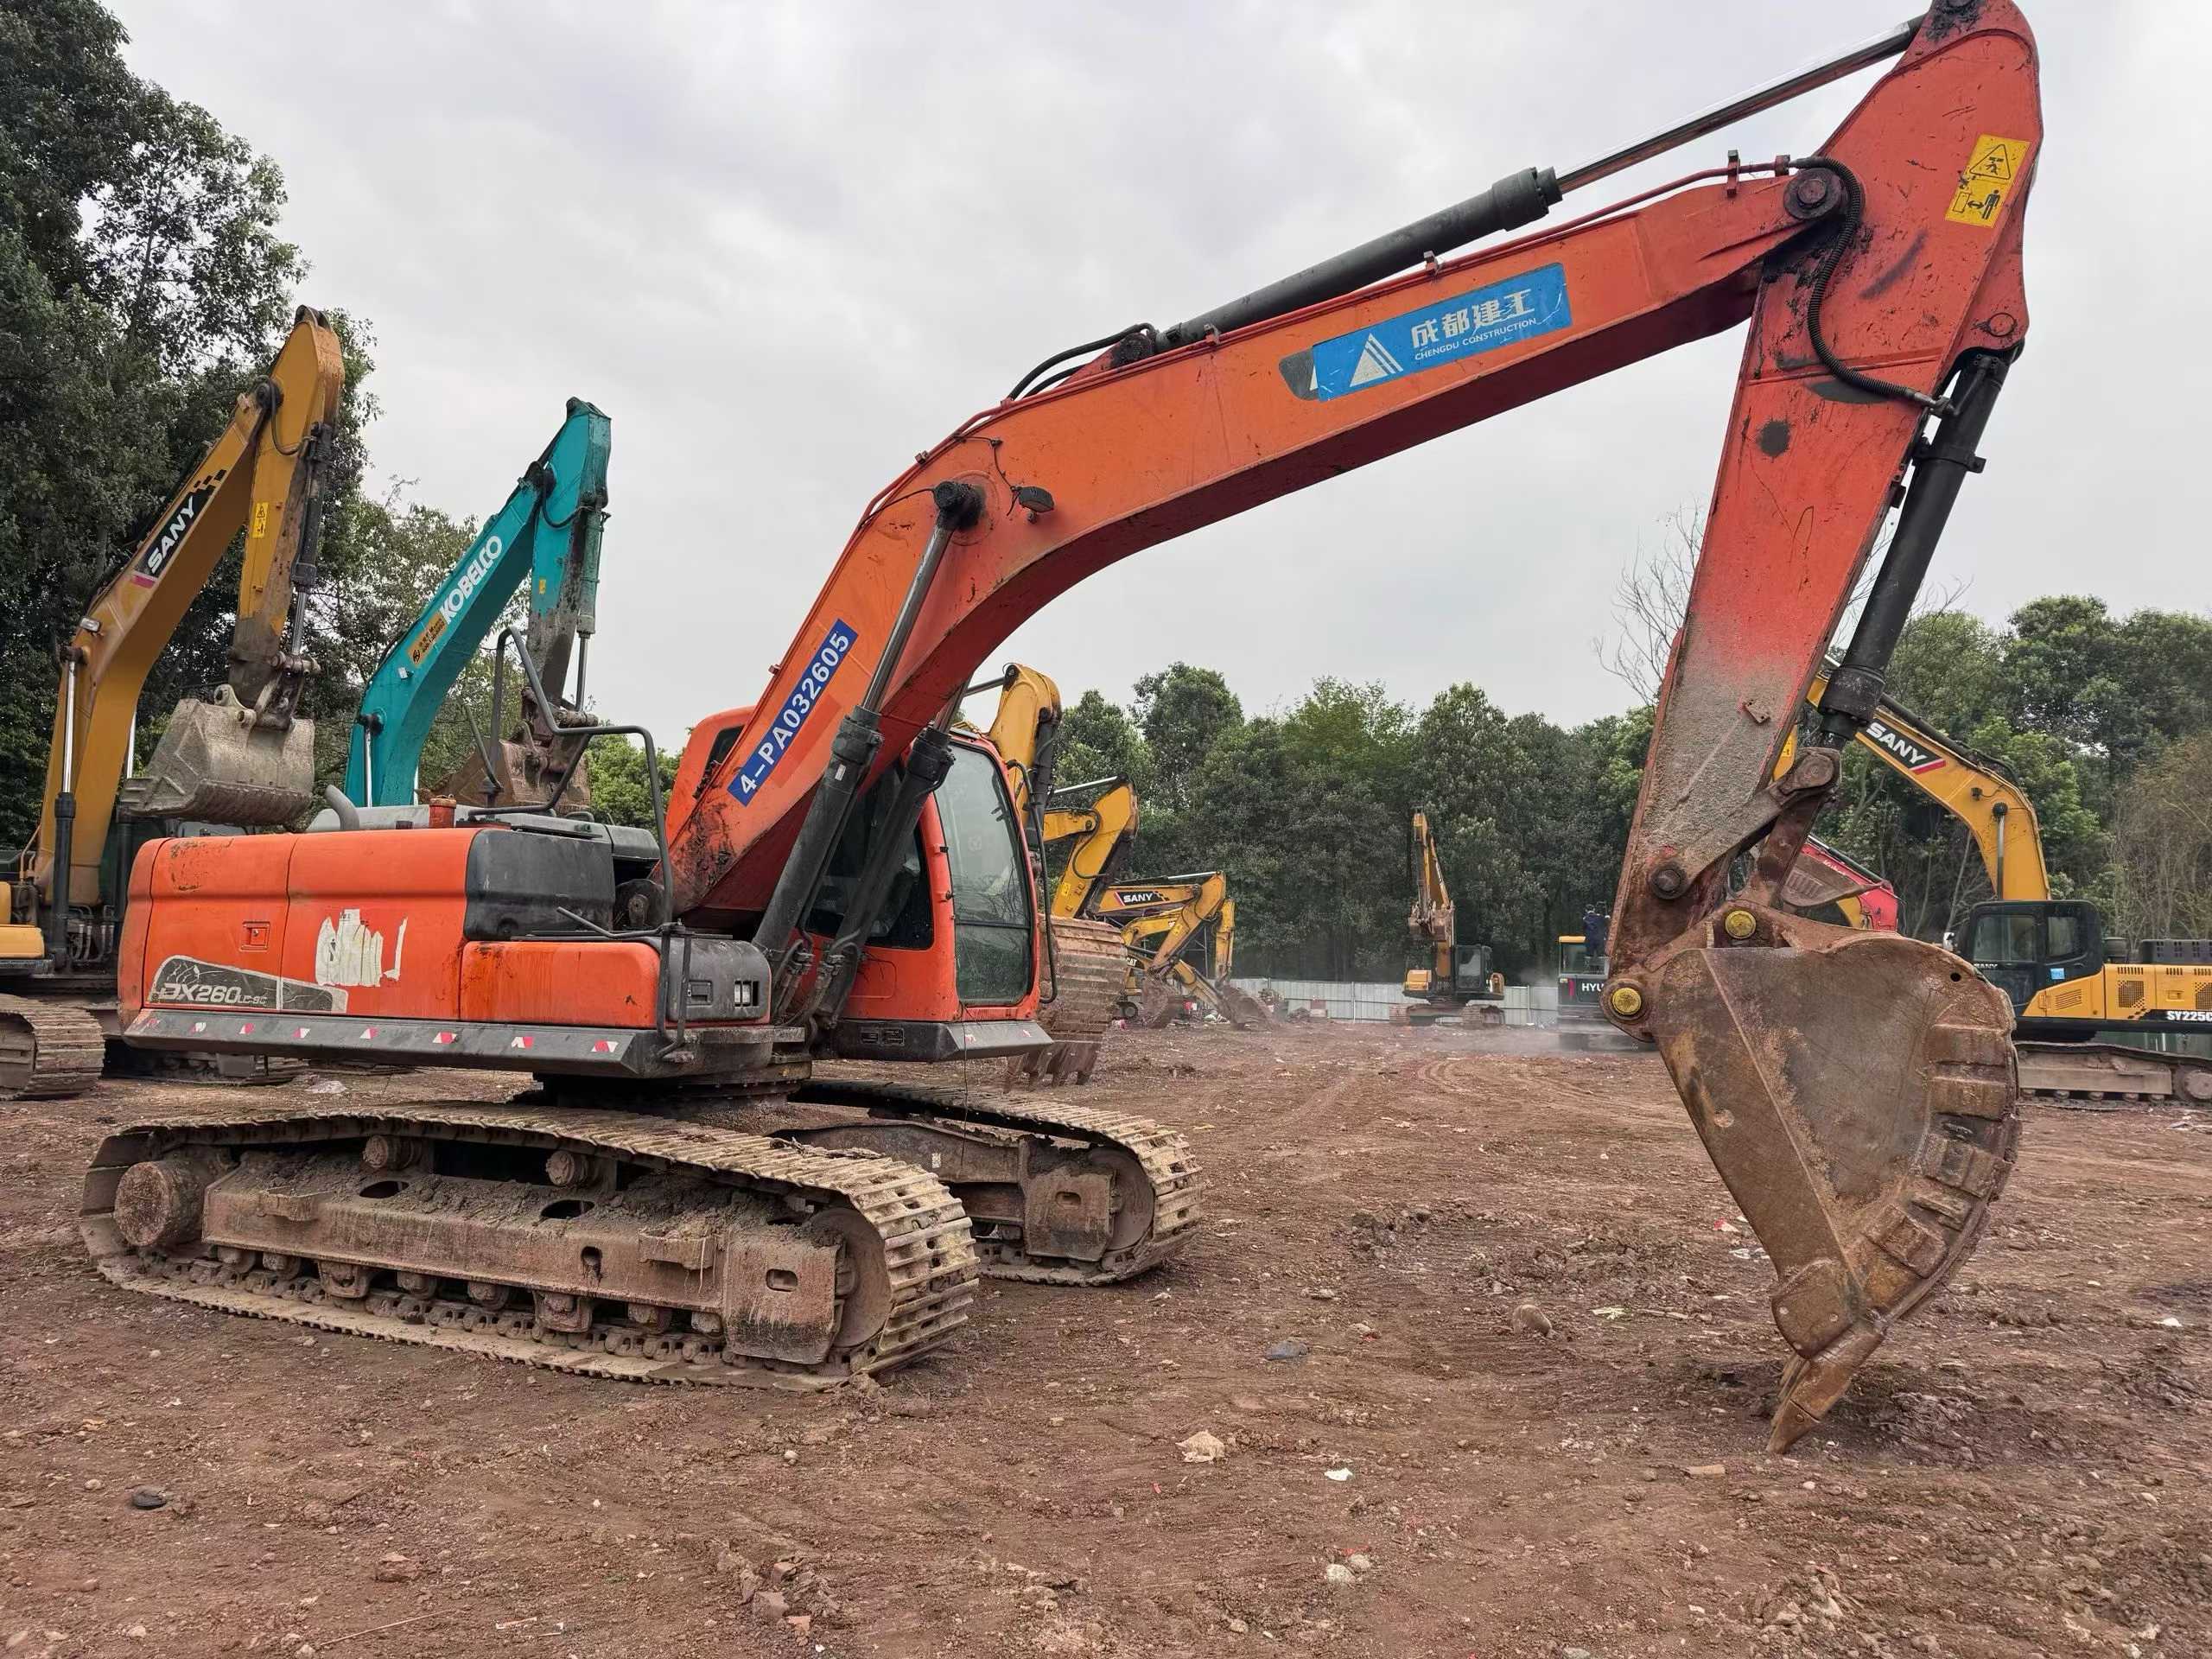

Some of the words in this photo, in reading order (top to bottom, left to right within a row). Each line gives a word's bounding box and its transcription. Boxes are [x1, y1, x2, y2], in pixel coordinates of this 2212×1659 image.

[1410, 289, 1535, 348] 成都建工
[1414, 340, 1460, 360] CHENGDU
[1462, 317, 1537, 346] CONSTRUCTION
[147, 495, 194, 575] SANY
[439, 535, 503, 625] KOBELCO
[741, 632, 849, 795] 4-PA032605
[1866, 721, 1929, 764] SANY
[1123, 893, 1153, 903] SANY
